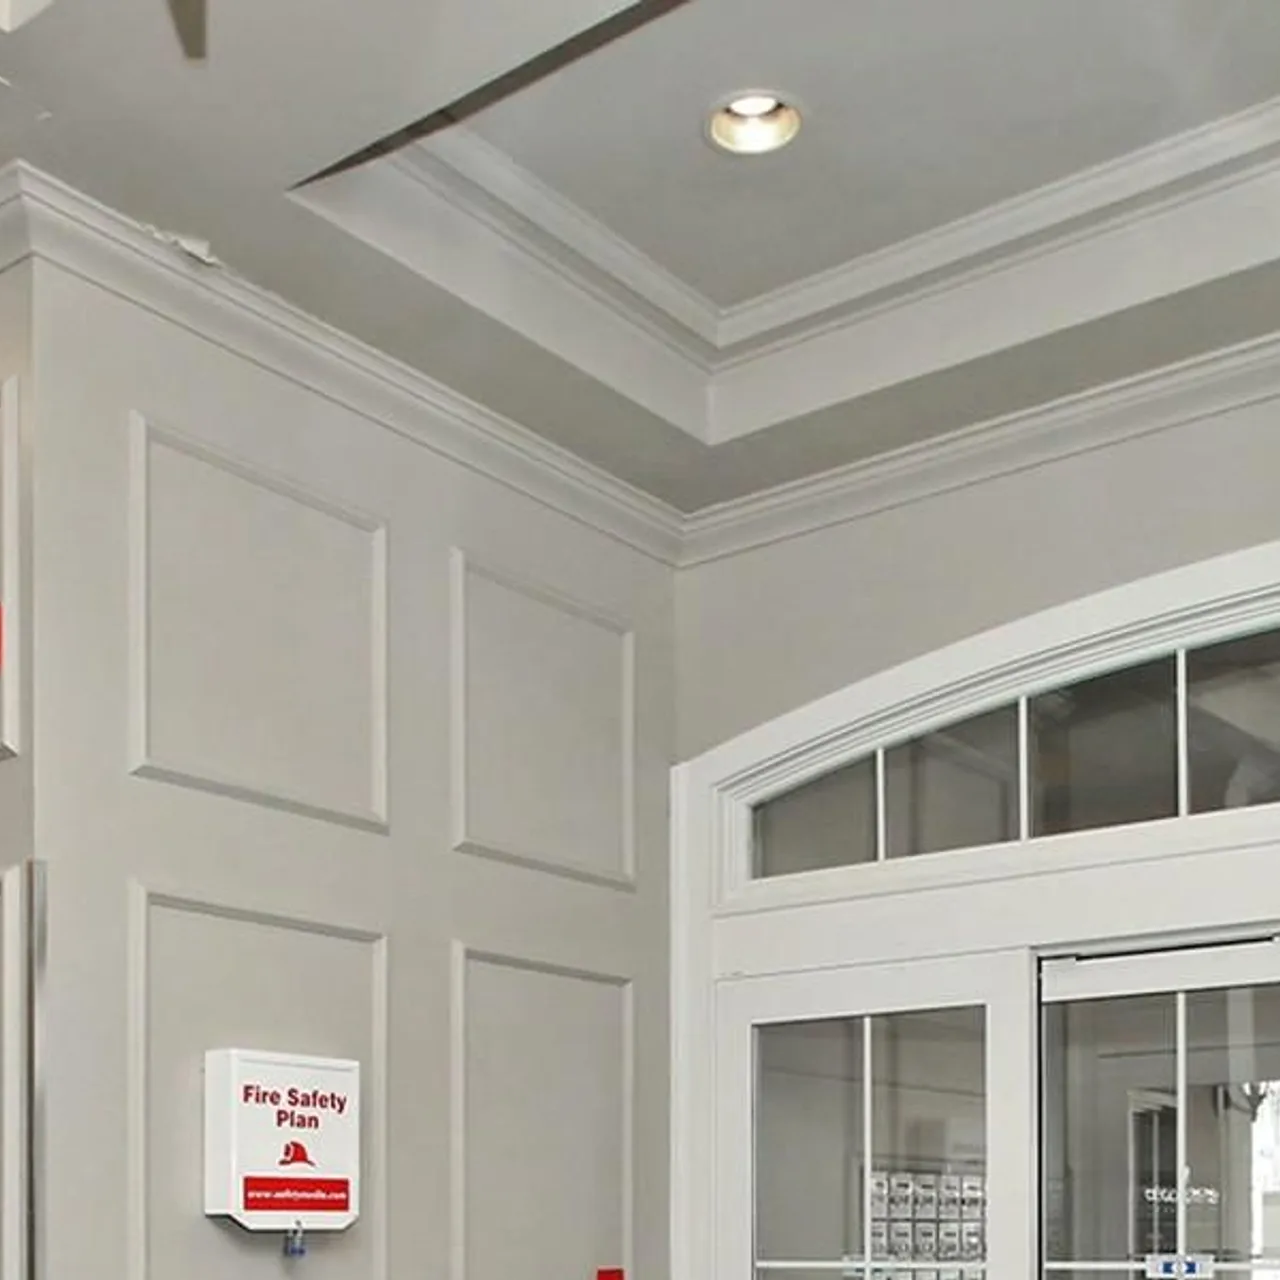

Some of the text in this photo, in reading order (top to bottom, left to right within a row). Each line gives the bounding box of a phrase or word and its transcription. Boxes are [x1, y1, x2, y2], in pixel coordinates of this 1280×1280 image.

[242, 1084, 348, 1114] Fire Safety
[276, 1109, 320, 1129] Plan
